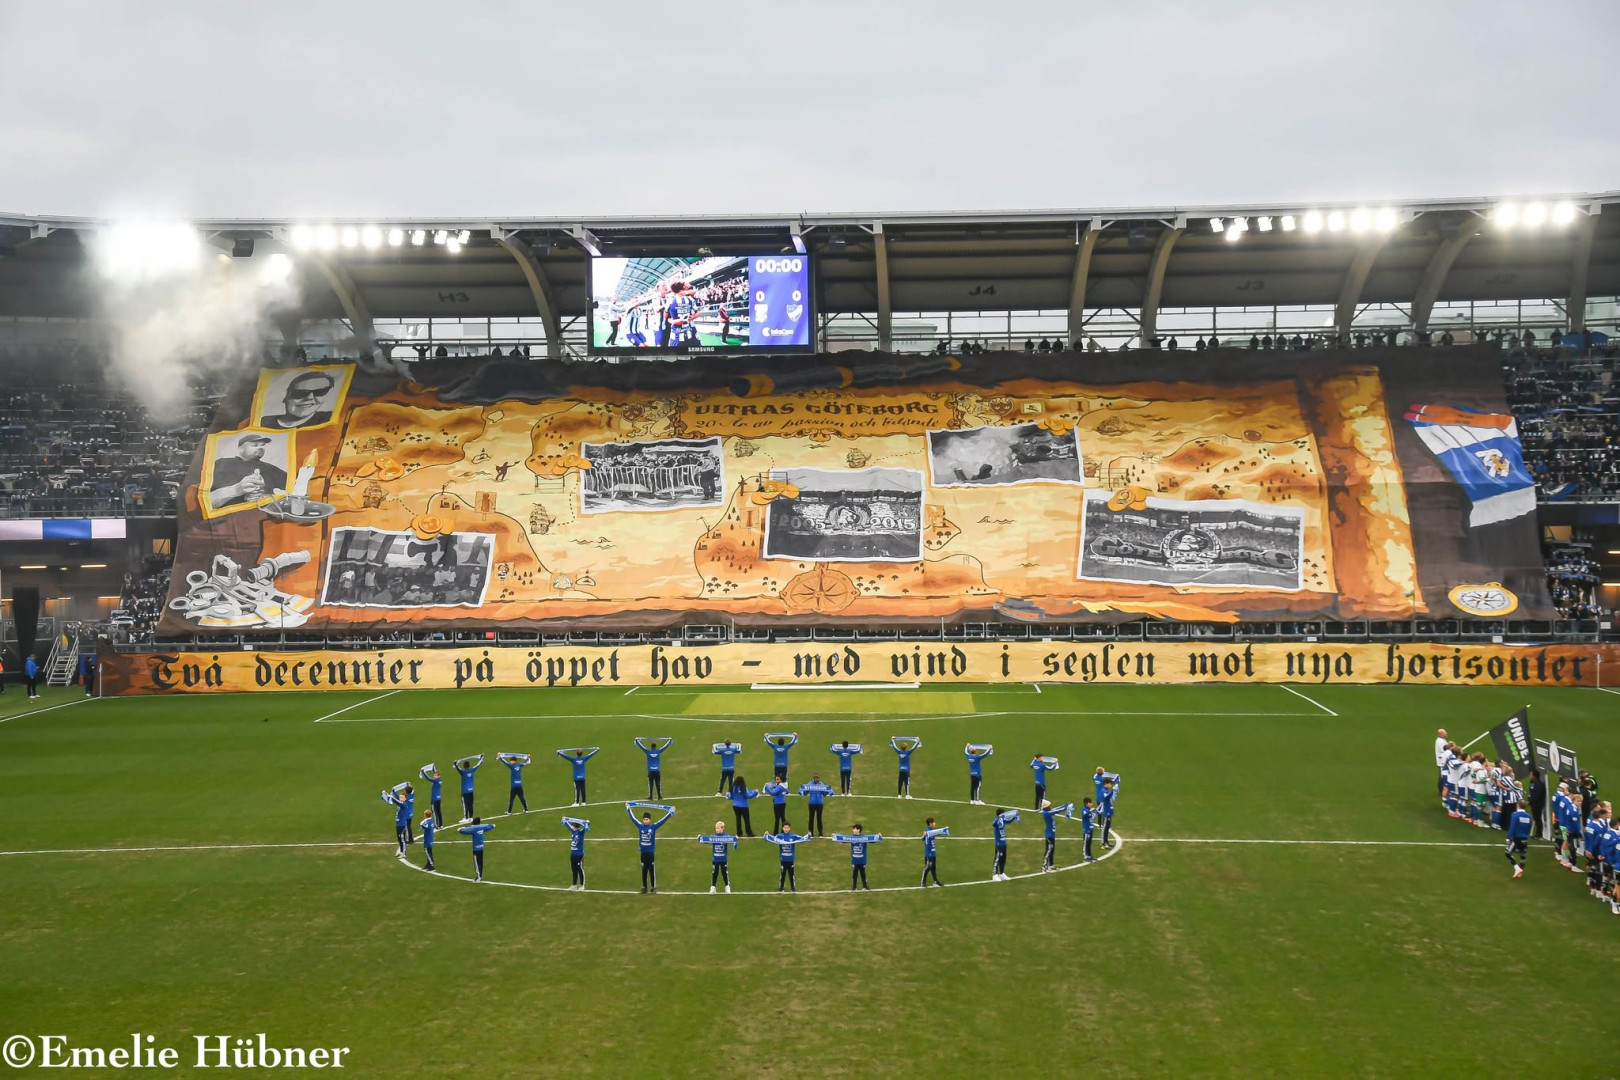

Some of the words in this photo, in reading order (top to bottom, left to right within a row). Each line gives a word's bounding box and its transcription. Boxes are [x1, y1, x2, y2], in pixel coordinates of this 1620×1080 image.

[755, 258, 803, 273] 00:00
[755, 290, 765, 302] 0
[792, 290, 802, 302] 0
[968, 285, 997, 296] J4
[695, 403, 795, 416] ULTRAS
[804, 401, 939, 415] GÖTEBORG
[695, 419, 716, 429] 20
[752, 420, 773, 429] av
[780, 417, 845, 430] passion
[850, 417, 876, 428] och
[882, 417, 940, 428] lidande
[870, 516, 916, 530] 2015
[151, 654, 224, 689] Två
[253, 652, 423, 688] decennier
[453, 650, 496, 690] på
[525, 648, 620, 690] öppet
[650, 645, 713, 686] hav
[792, 646, 861, 678] med
[890, 646, 968, 678] vind
[999, 644, 1011, 678] i
[1042, 643, 1157, 683] seglen
[1188, 644, 1255, 677] mot
[1284, 650, 1354, 684] nya
[1385, 644, 1588, 682] horisonter
